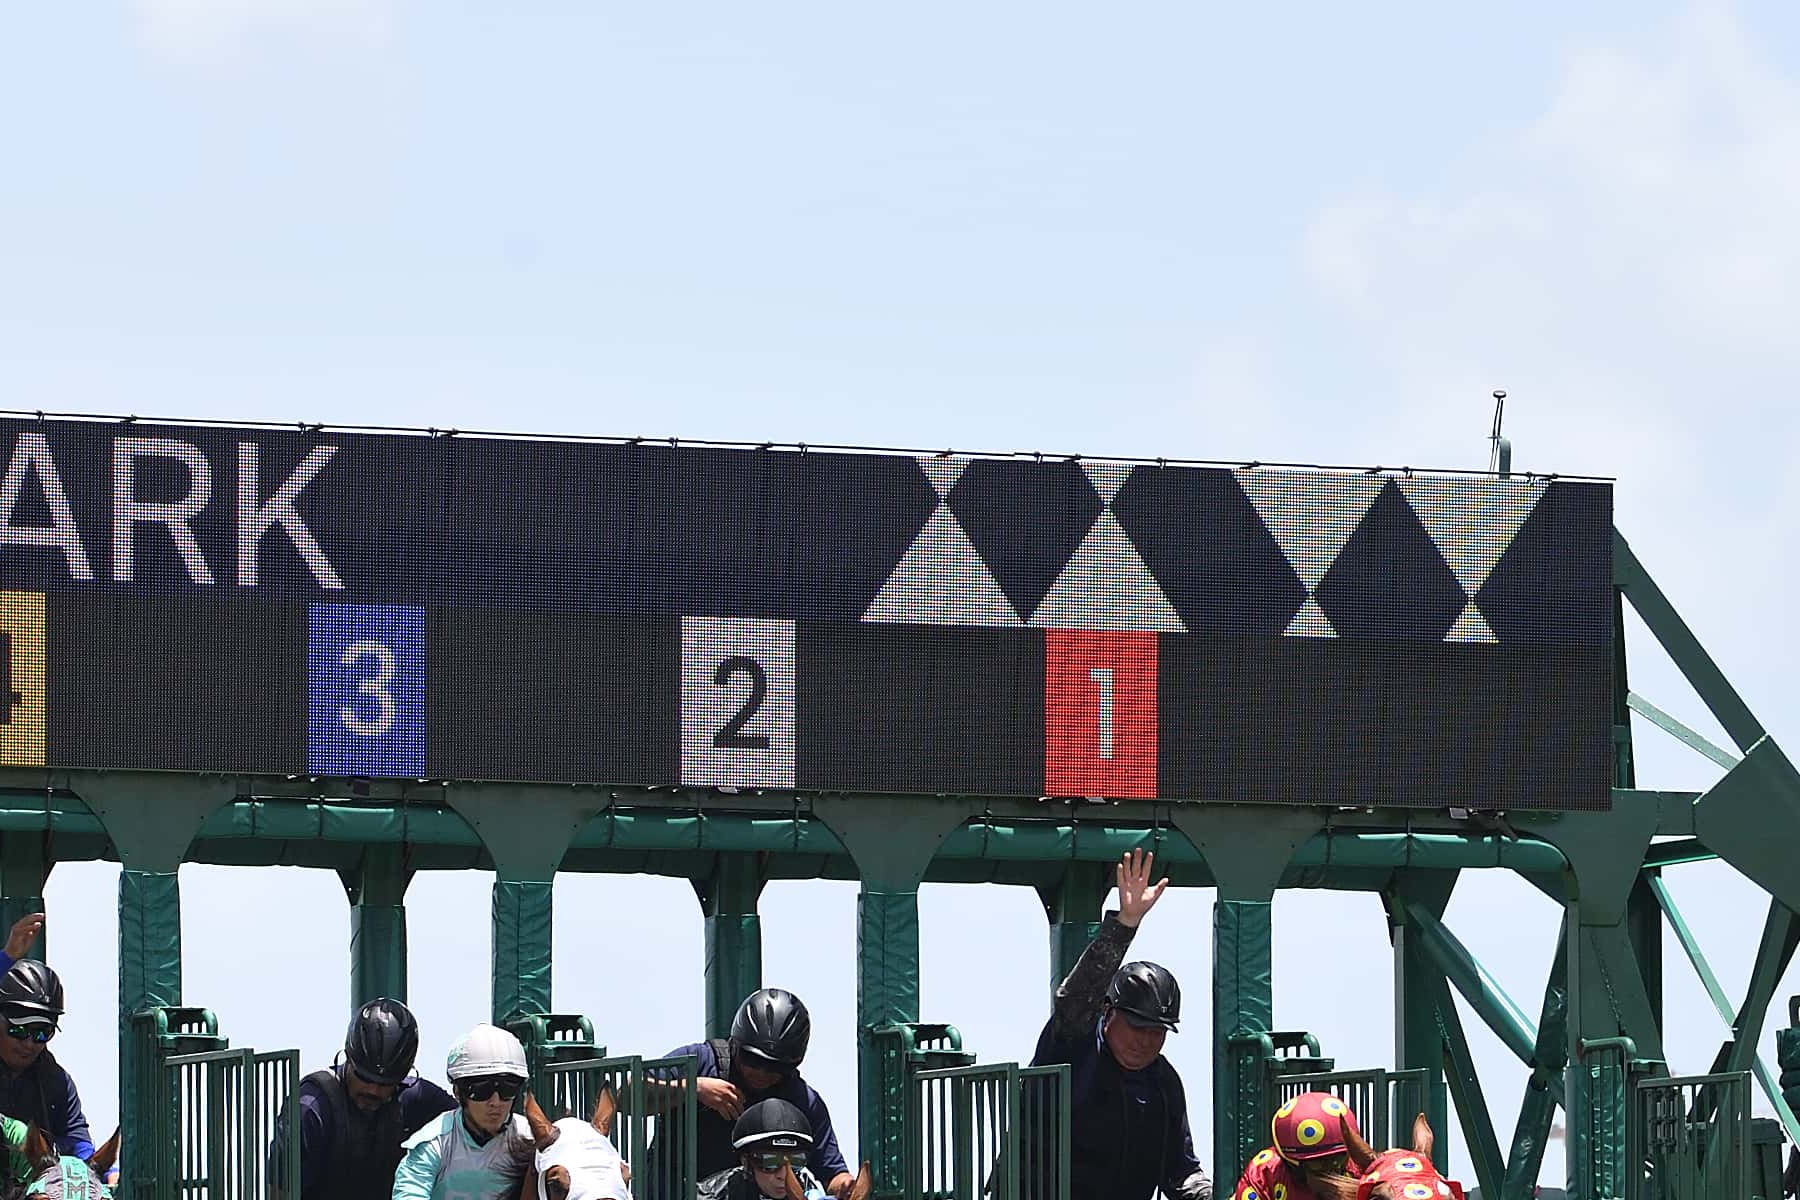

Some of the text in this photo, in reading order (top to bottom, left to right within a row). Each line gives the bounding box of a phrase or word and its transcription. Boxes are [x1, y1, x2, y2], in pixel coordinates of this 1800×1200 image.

[340, 640, 395, 737] 3
[712, 654, 771, 750] 2
[1089, 667, 1114, 760] 1
